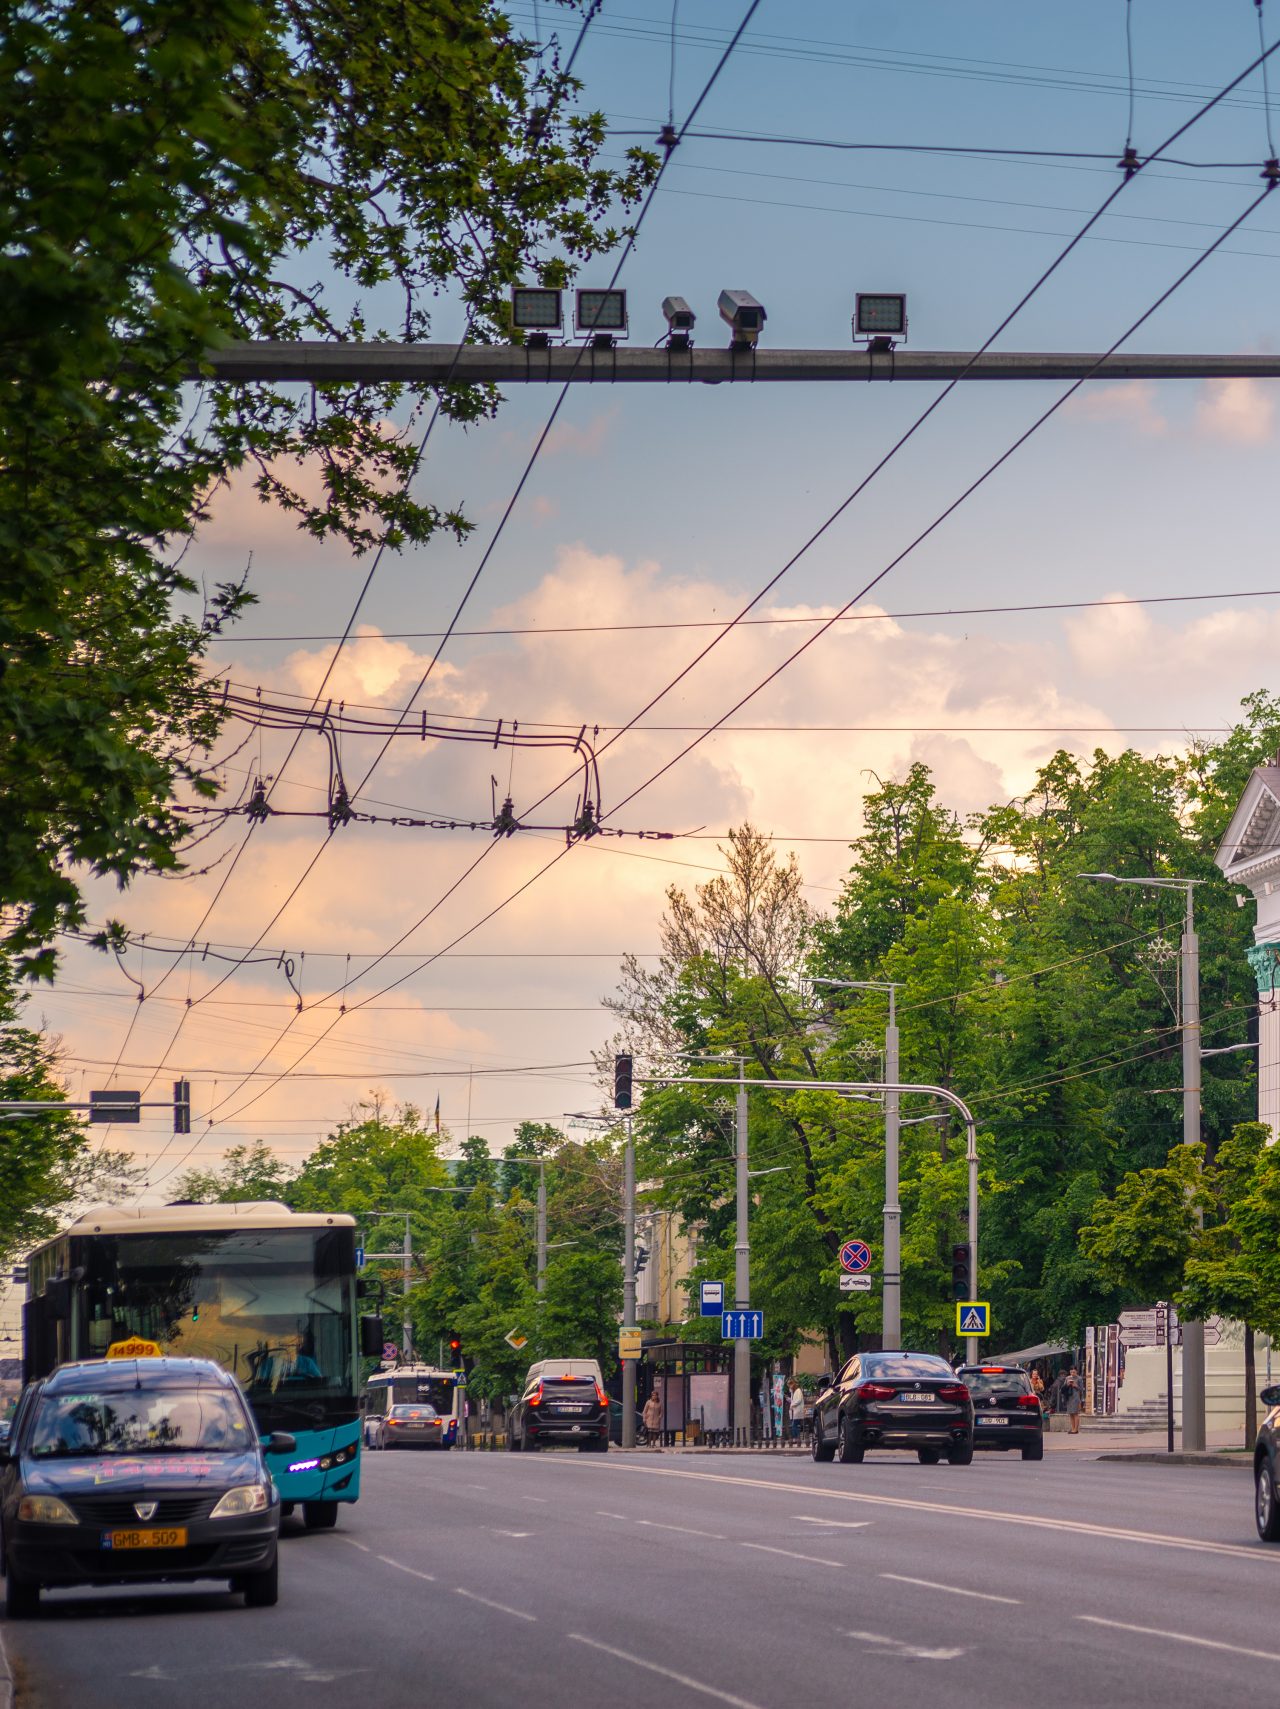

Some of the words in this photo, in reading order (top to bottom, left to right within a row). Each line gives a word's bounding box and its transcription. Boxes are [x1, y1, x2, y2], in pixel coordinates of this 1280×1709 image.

[113, 1343, 155, 1356] 14999
[113, 1533, 140, 1547] GMB
[152, 1531, 178, 1545] 509
